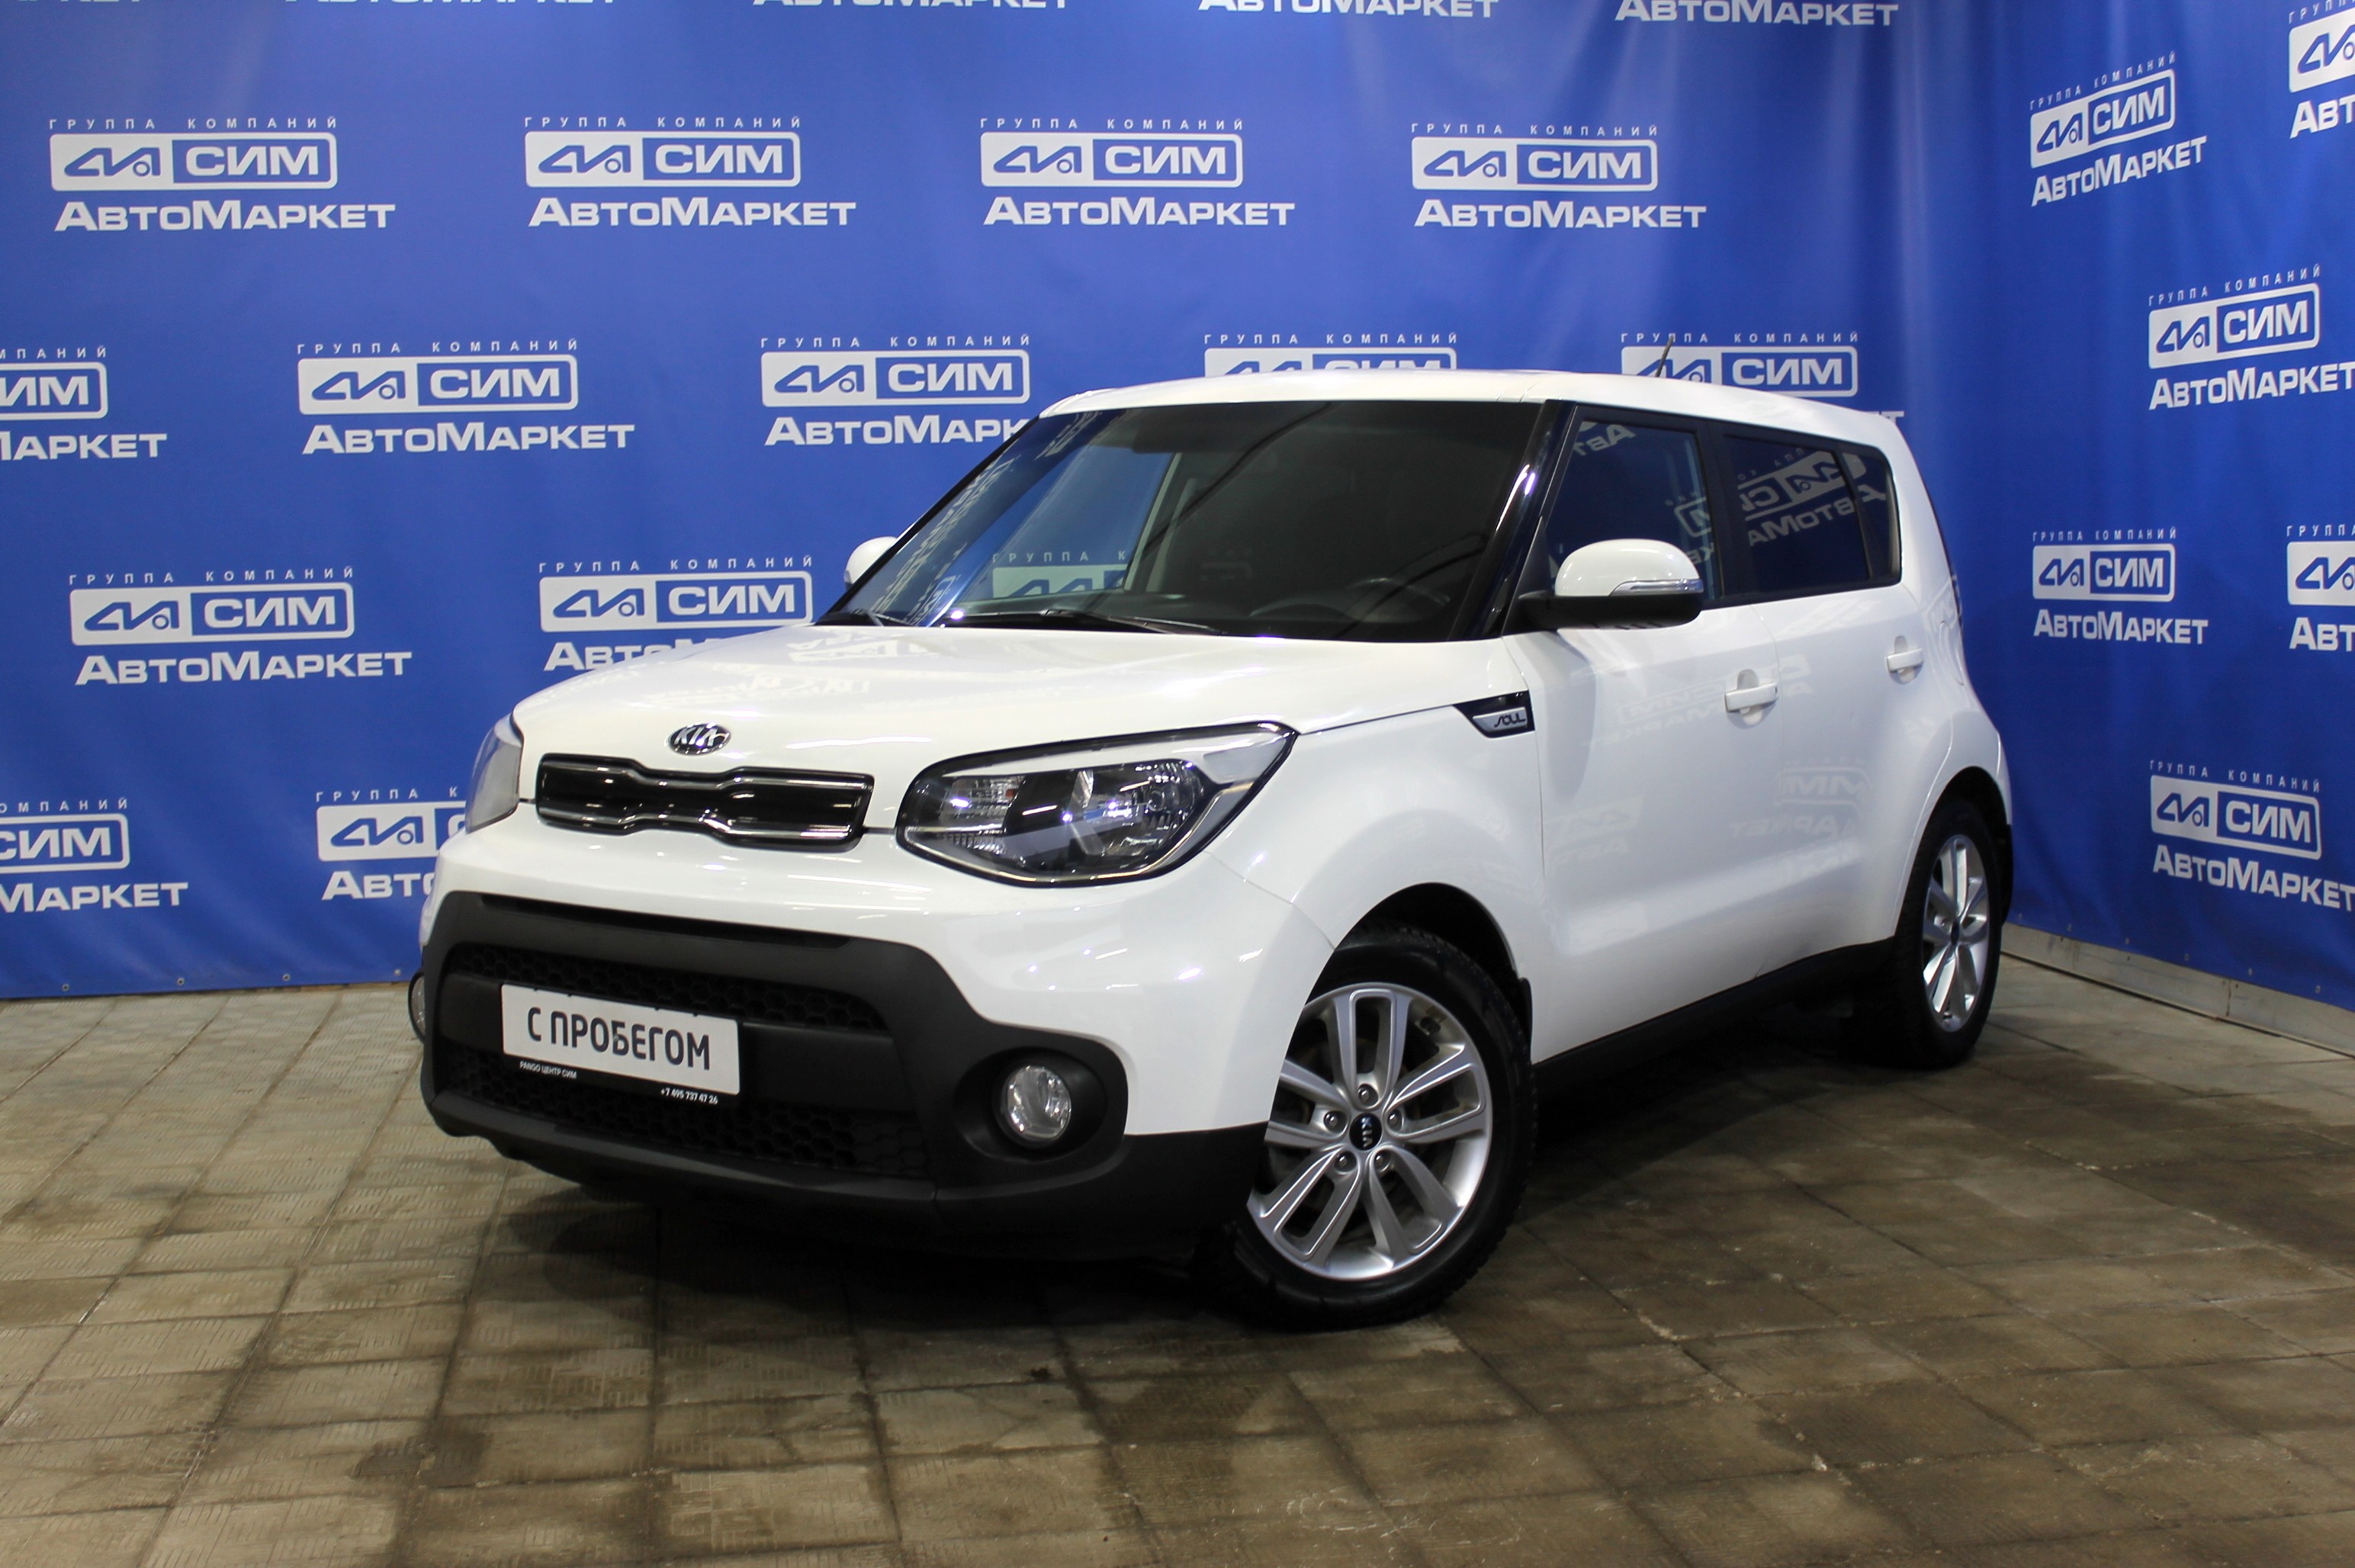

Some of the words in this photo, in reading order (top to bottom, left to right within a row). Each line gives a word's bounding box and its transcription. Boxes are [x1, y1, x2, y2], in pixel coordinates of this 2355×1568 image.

[2030, 85, 2081, 111] ГРУППА
[2094, 50, 2176, 88] КОМПАНИЙ
[50, 118, 154, 129] ГРУППА
[188, 116, 336, 128] КОМПАНИЙ
[525, 117, 625, 127] ГРУППА
[658, 117, 799, 127] КОМПАНИЙ
[981, 118, 1077, 128] ГРУППА
[1107, 119, 1242, 130] КОМПАНИЙ
[2093, 85, 2164, 136] СИМ
[1412, 123, 1502, 133] ГРУППА
[1531, 124, 1657, 136] КОМПАНИЙ
[186, 146, 318, 175] СИМ
[656, 144, 782, 173] СИМ
[1105, 146, 1226, 174] СИМ
[1528, 151, 1641, 178] СИМ
[2031, 135, 2208, 207] АвтоМаркет
[55, 200, 395, 231] АвтоМаркет
[529, 197, 856, 227] АвтоМаркет
[984, 197, 1295, 225] АвтоМаркет
[1415, 199, 1706, 227] АвтоМаркет
[2148, 286, 2208, 307] ГРУППА
[2225, 263, 2320, 293] КОМПАНИЙ
[2224, 300, 2308, 344] СИМ
[297, 342, 400, 354] ГРУППА
[432, 339, 577, 352] КОМПАНИЙ
[761, 337, 859, 348] ГРУППА
[891, 334, 1029, 346] КОМПАНИЙ
[1205, 334, 1297, 344] ГРУППА
[1327, 333, 1456, 343] КОМПАНИЙ
[1621, 333, 1708, 343] ГРУППА
[1735, 332, 1857, 342] КОМПАНИЙ
[430, 368, 559, 398] СИМ
[888, 363, 1012, 392] СИМ
[1733, 358, 1842, 385] СИМ
[2148, 361, 2355, 410] АвтоМаркет
[0, 431, 167, 460] аркет
[303, 422, 635, 454] АвтоМаркет
[2033, 531, 2083, 541] ГРУППА
[2096, 526, 2176, 541] КОМПАНИЙ
[539, 561, 639, 573] ГРУППА
[671, 555, 811, 570] КОМПАНИЙ
[993, 552, 1089, 563] ГРУППА
[2096, 557, 2164, 587] СИМ
[69, 573, 173, 585] ГРУППА
[206, 566, 352, 581] КОМПАНИЙ
[204, 596, 336, 628] СИМ
[669, 584, 795, 615] СИМ
[2034, 609, 2209, 644] АвтоМаркет
[76, 651, 412, 685] АвтоМаркет
[1494, 713, 1526, 728] SOUL
[2150, 760, 2208, 777] ГРУППА
[2228, 770, 2319, 793] КОМПАНИЙ
[316, 789, 418, 802] ГРУППА
[2226, 800, 2311, 843] СИМ
[2153, 844, 2355, 911] АвтоМаркет
[528, 1007, 541, 1042] С
[551, 1011, 710, 1070] ПРОБЕГОМ
